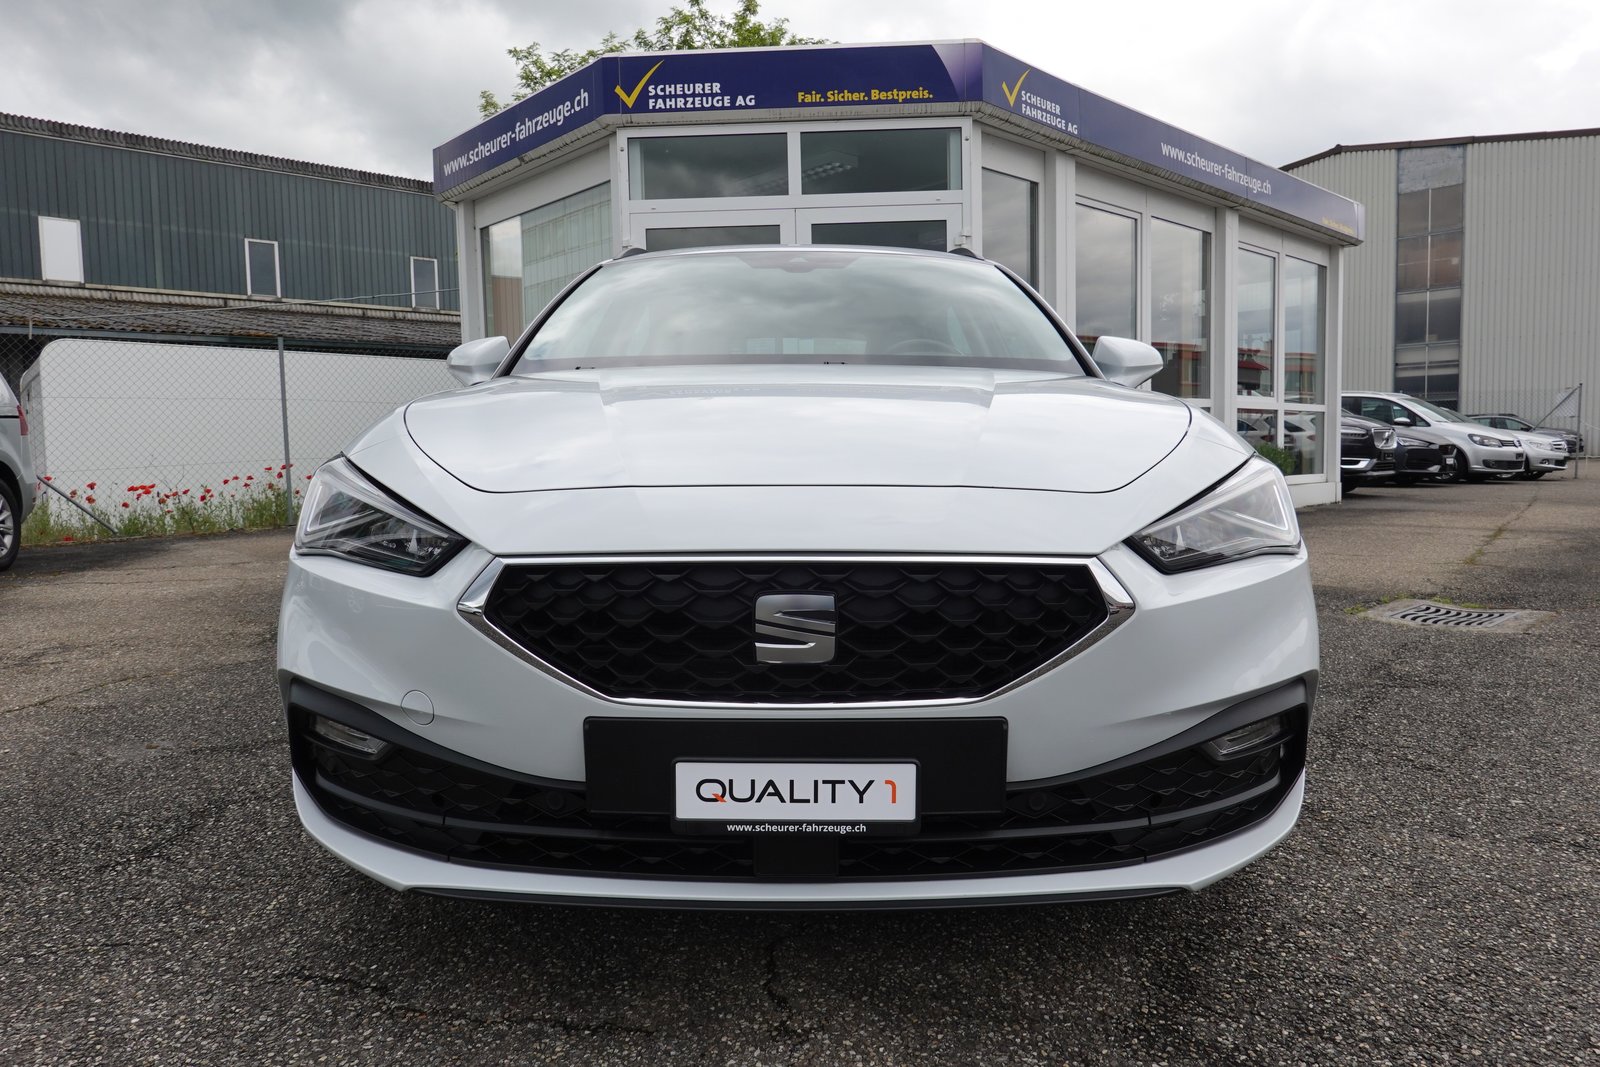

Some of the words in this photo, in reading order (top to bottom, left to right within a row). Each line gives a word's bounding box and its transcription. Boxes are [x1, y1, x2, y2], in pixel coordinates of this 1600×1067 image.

[648, 83, 721, 96] SCHEURER
[797, 91, 825, 103] Fair.
[827, 88, 868, 102] Sicher.
[871, 87, 933, 102] Bestpreis.
[648, 96, 731, 110] FAHRZEUGE
[735, 95, 755, 106] AG
[1021, 91, 1061, 115] SCHEURER
[1021, 104, 1066, 130] FAHRZEUGE
[1067, 123, 1078, 134] AG
[443, 88, 589, 177] www.scheurer-fahrzeuge.ch
[1161, 142, 1272, 195] www.scheurer-fahrzeuge.ch
[695, 778, 875, 804] QUALITY
[884, 779, 897, 804] 1
[727, 823, 867, 834] www.scheurer-fahrzeuge.ch
